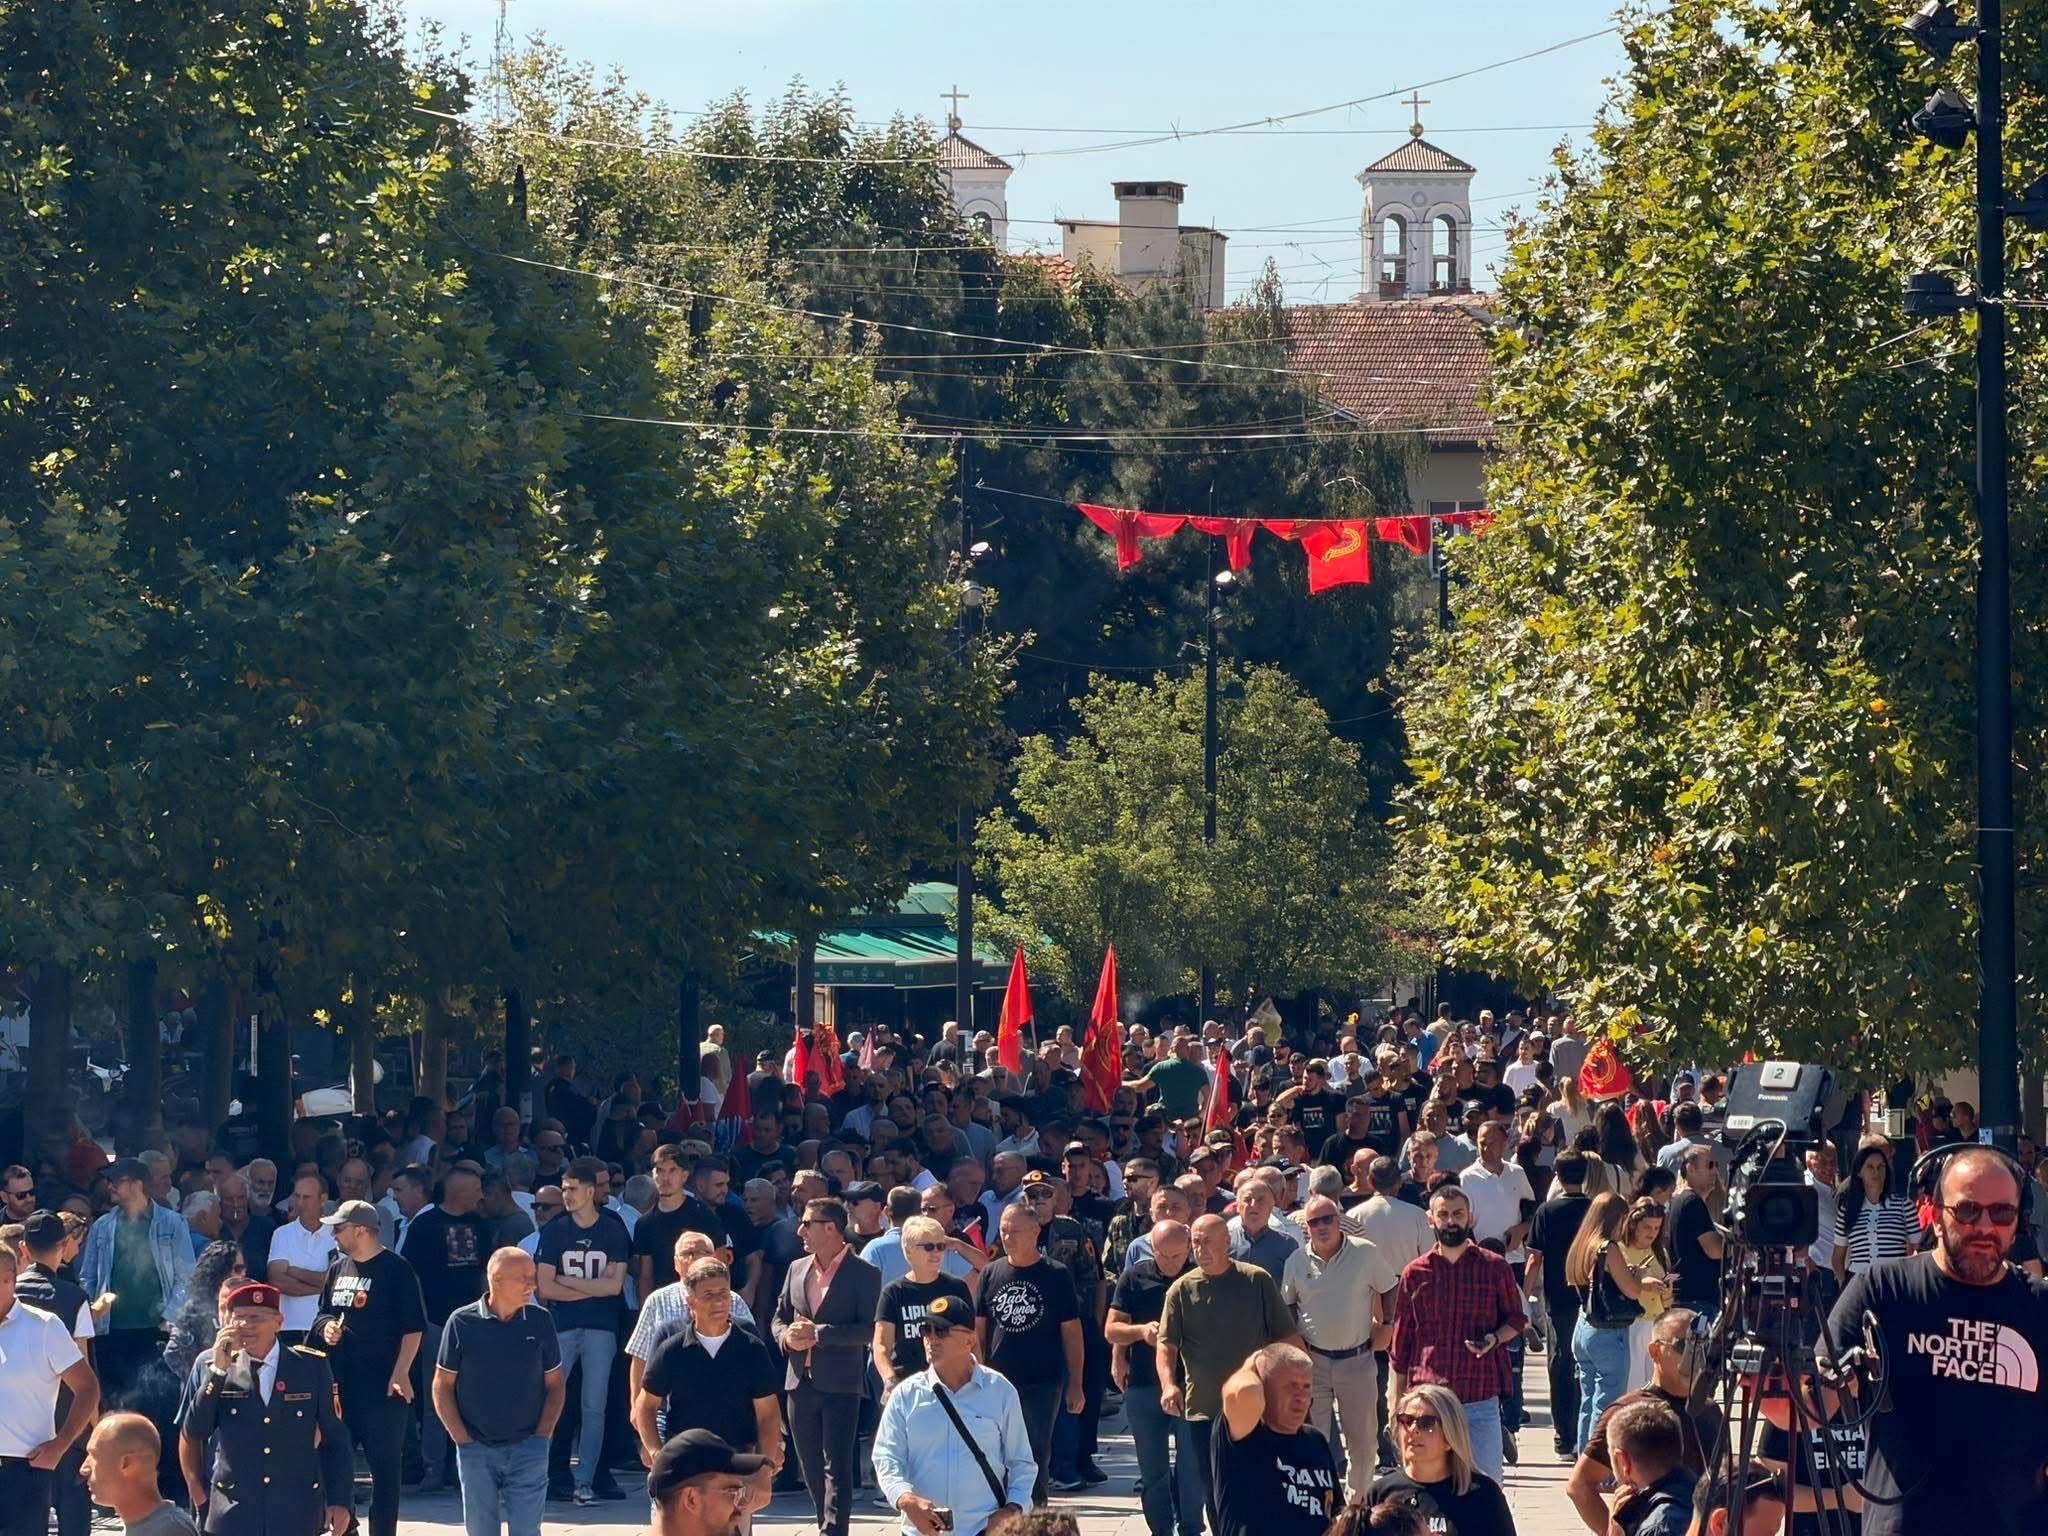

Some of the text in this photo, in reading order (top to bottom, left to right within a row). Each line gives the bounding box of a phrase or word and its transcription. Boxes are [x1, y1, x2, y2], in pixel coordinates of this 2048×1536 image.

[1774, 1068, 1784, 1079] 2
[1947, 1318, 1995, 1342] THE
[1907, 1333, 1996, 1363] NORTH
[1932, 1355, 1994, 1384] FACE
